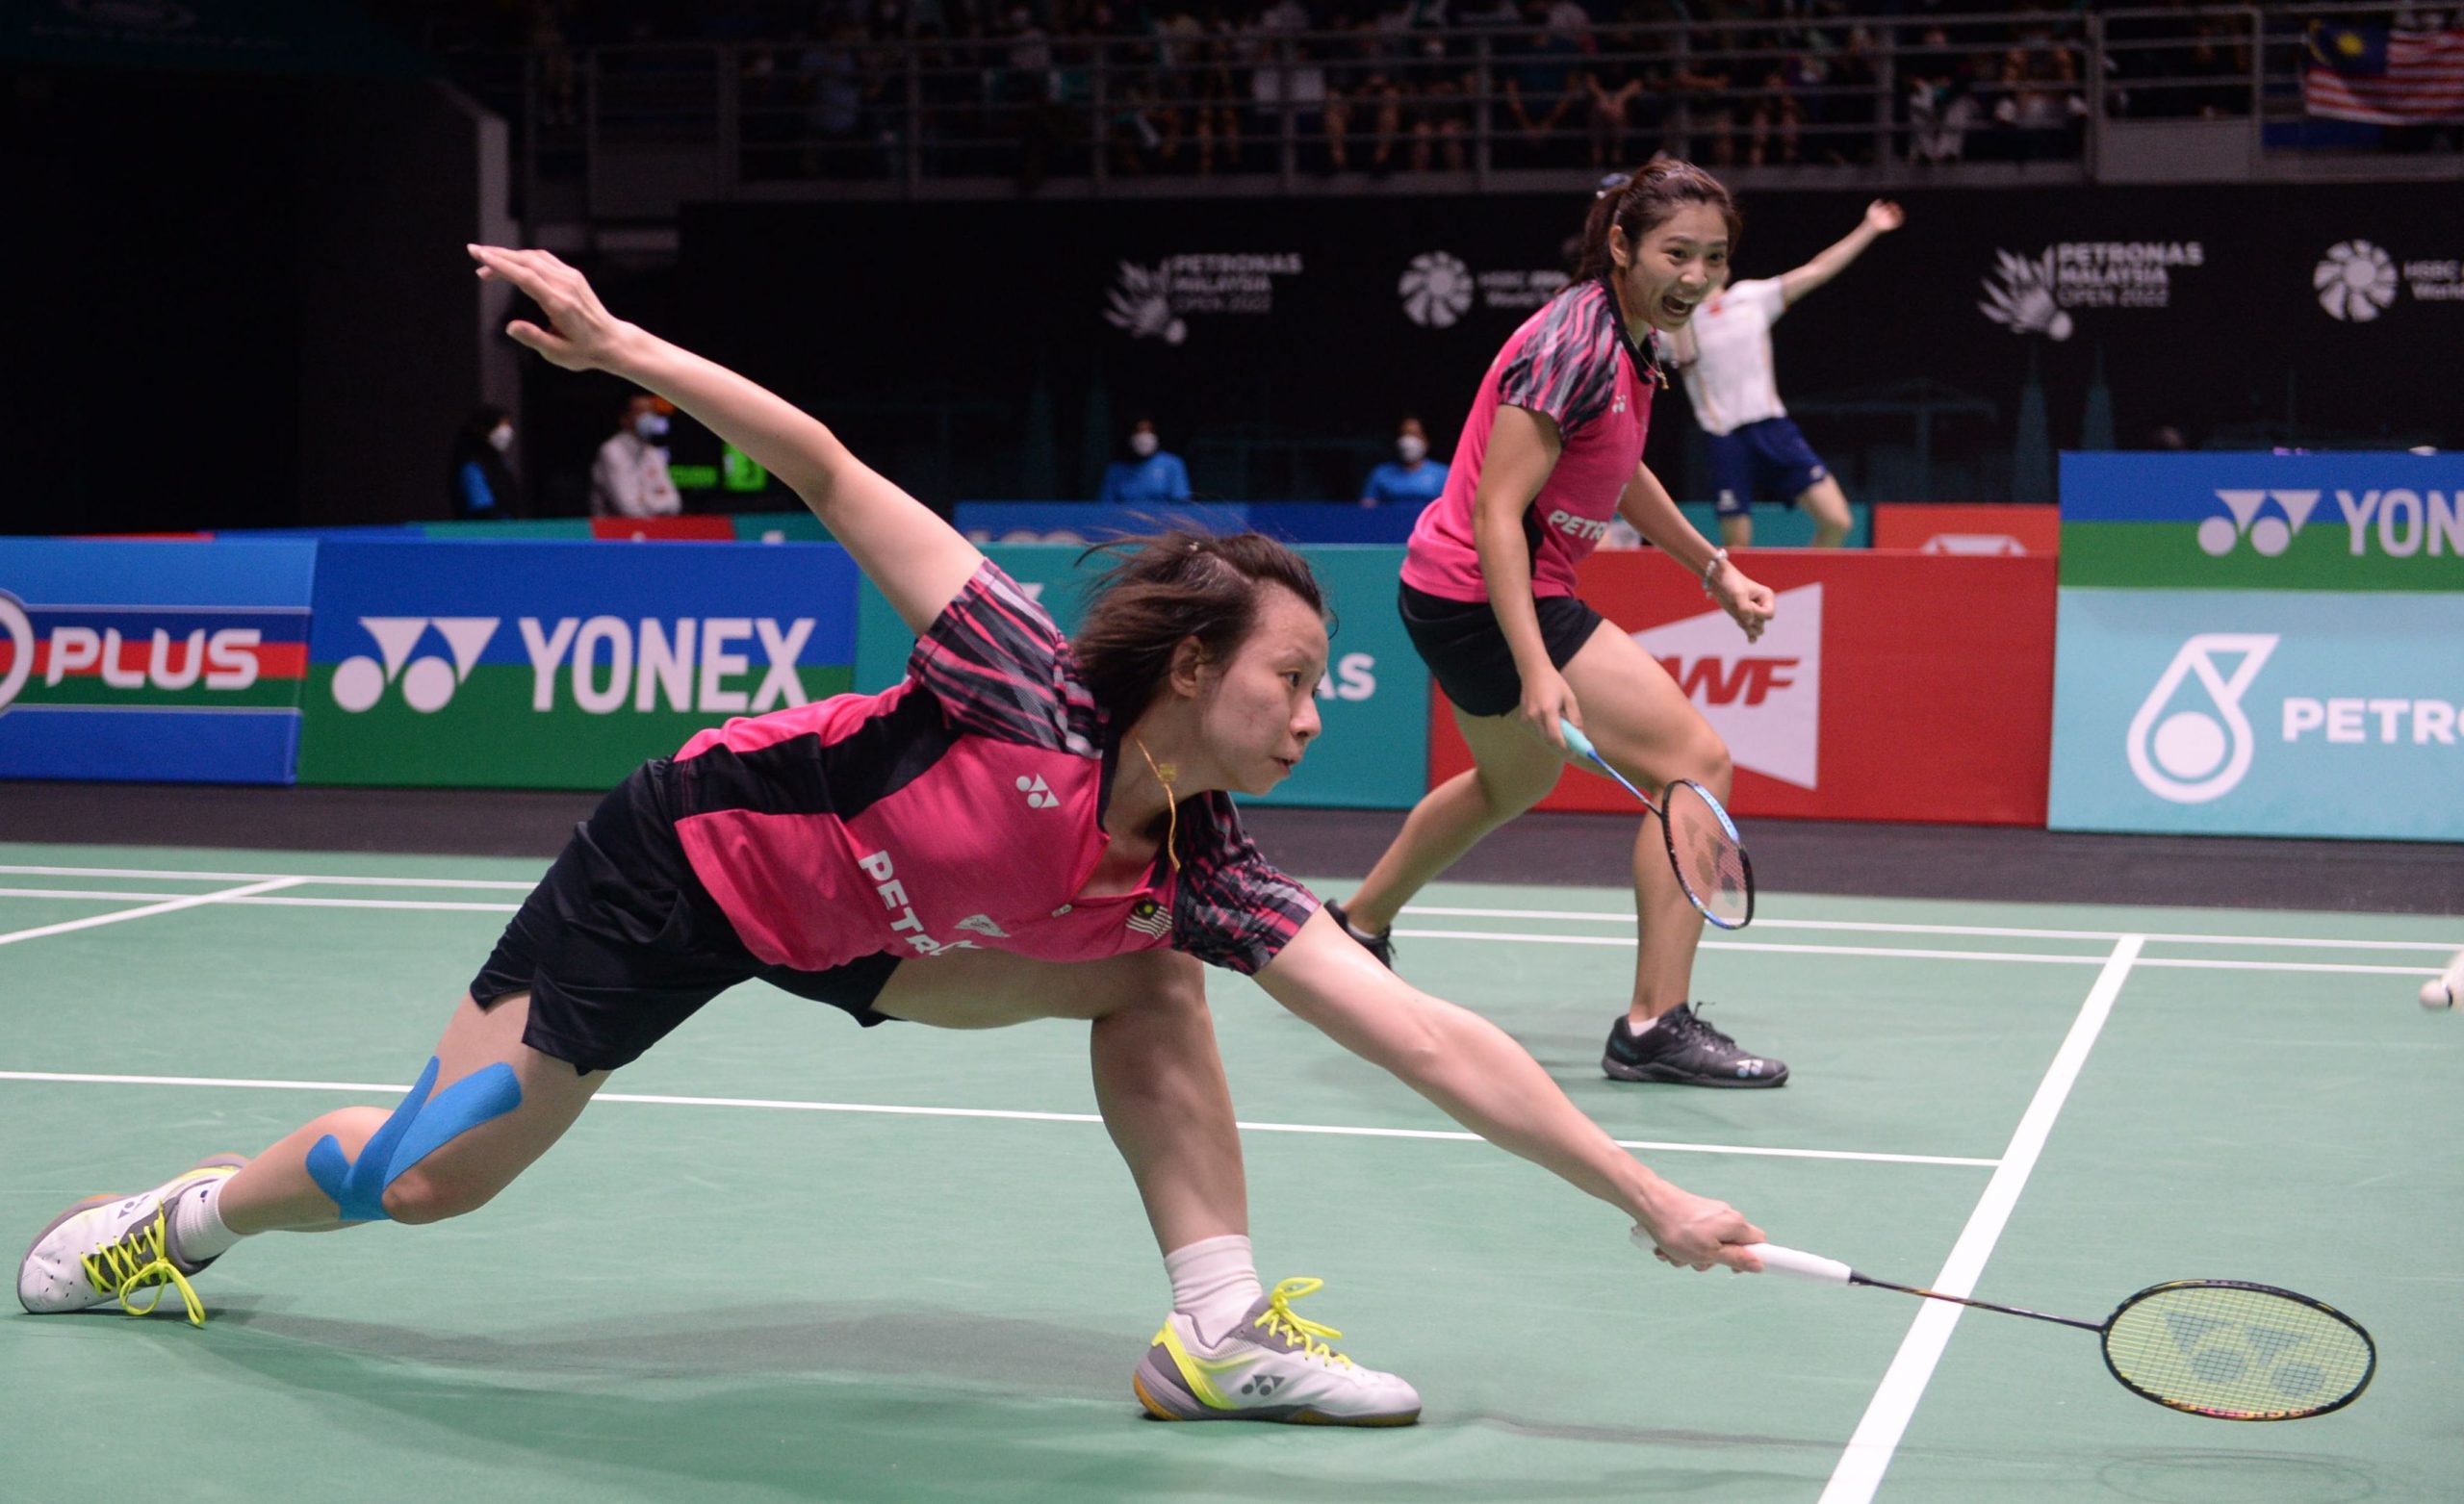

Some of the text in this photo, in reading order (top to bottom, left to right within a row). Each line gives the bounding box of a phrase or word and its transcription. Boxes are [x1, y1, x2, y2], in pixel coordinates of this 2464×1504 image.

[1171, 253, 1303, 274] PETRONAS
[2058, 242, 2204, 266] PETRONAS
[2058, 267, 2169, 285] MALAYSIA
[2058, 286, 2116, 307] OPEN
[45, 626, 262, 690] PLUS
[519, 616, 816, 714] YONEX
[1655, 654, 1801, 707] WF
[2281, 698, 2464, 745] PETR
[859, 850, 983, 956] PETR
